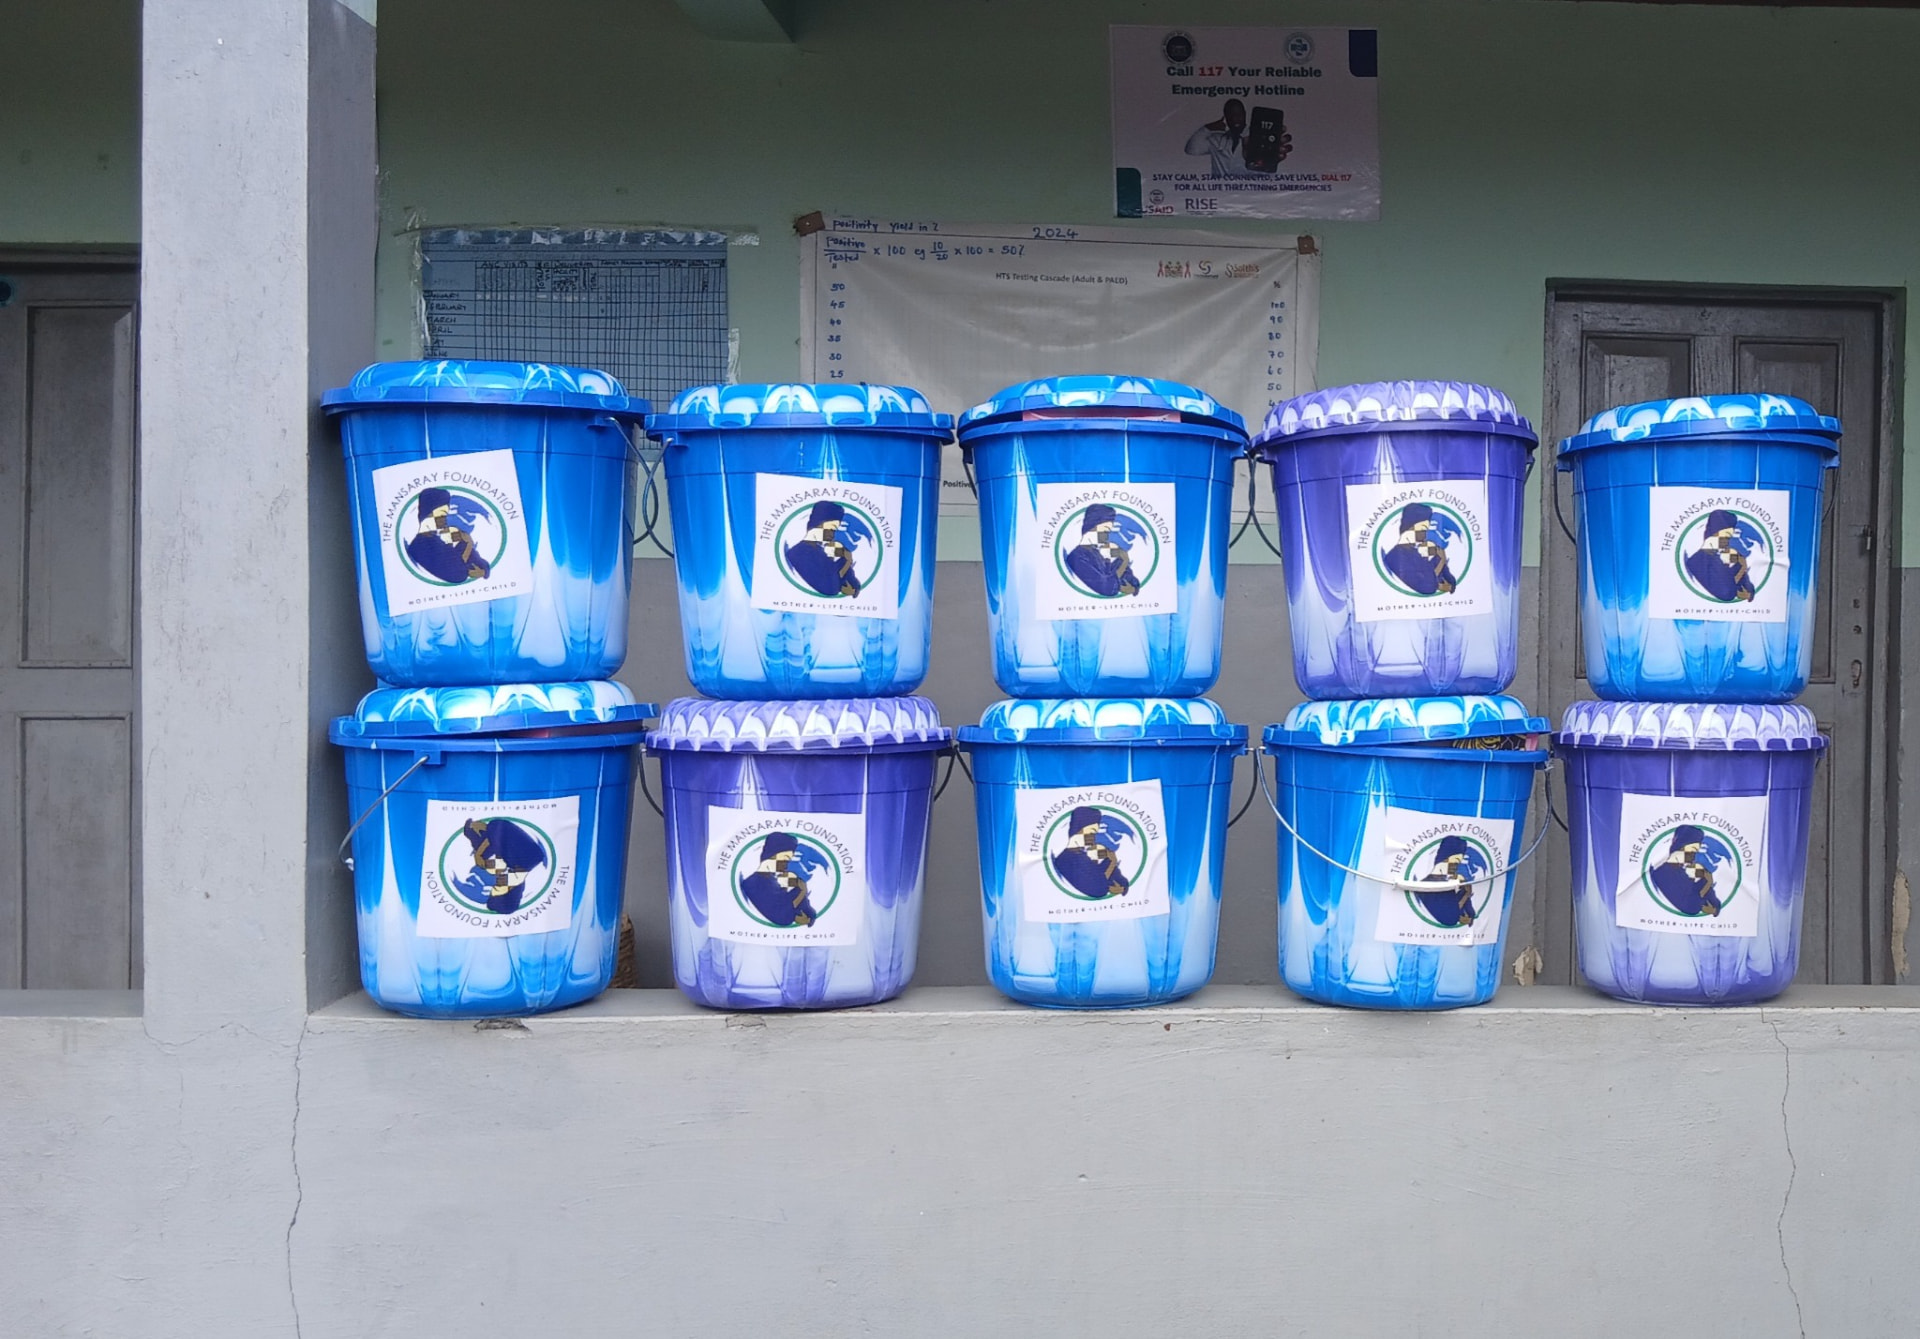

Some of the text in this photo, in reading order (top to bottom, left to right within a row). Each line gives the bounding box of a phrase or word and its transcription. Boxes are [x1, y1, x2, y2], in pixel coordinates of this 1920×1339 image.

[1166, 66, 1323, 78] Call 117 Your Reliable
[1171, 84, 1305, 98] Emergency Hotline
[1261, 121, 1274, 130] 117
[1175, 174, 1199, 183] CALM,
[1274, 174, 1296, 182] SAVE
[1321, 174, 1340, 182] DIAL
[1185, 198, 1218, 210] RISE
[1033, 227, 1079, 239] 2024
[887, 245, 906, 256] 100
[995, 272, 1011, 280] HTS
[1012, 273, 1039, 282] Testing
[1040, 274, 1070, 282] Cascade
[1267, 383, 1281, 391] 50
[383, 471, 519, 542] THE MANSARAY FOUNDATION
[760, 487, 894, 548] THE MANSARAY FOUNDATION
[1041, 490, 1171, 549] THE MANSARAY FOUNDATION
[1357, 489, 1483, 550] THE MANSARAY FOUNDATION
[1661, 496, 1783, 553] THE MANSARAY FOUNDATION
[408, 594, 446, 605] MOTHER
[1030, 791, 1159, 853] THE MANSARAY FOUNDATION
[718, 818, 854, 874] THE MANSARAY FOUNDATION
[1390, 854, 1407, 874] THE
[1405, 823, 1464, 855] MANSARAY
[1629, 812, 1753, 867] THE MANSARAY FOUNDATION
[425, 865, 570, 929] THE MANSARAY FOUNDATION
